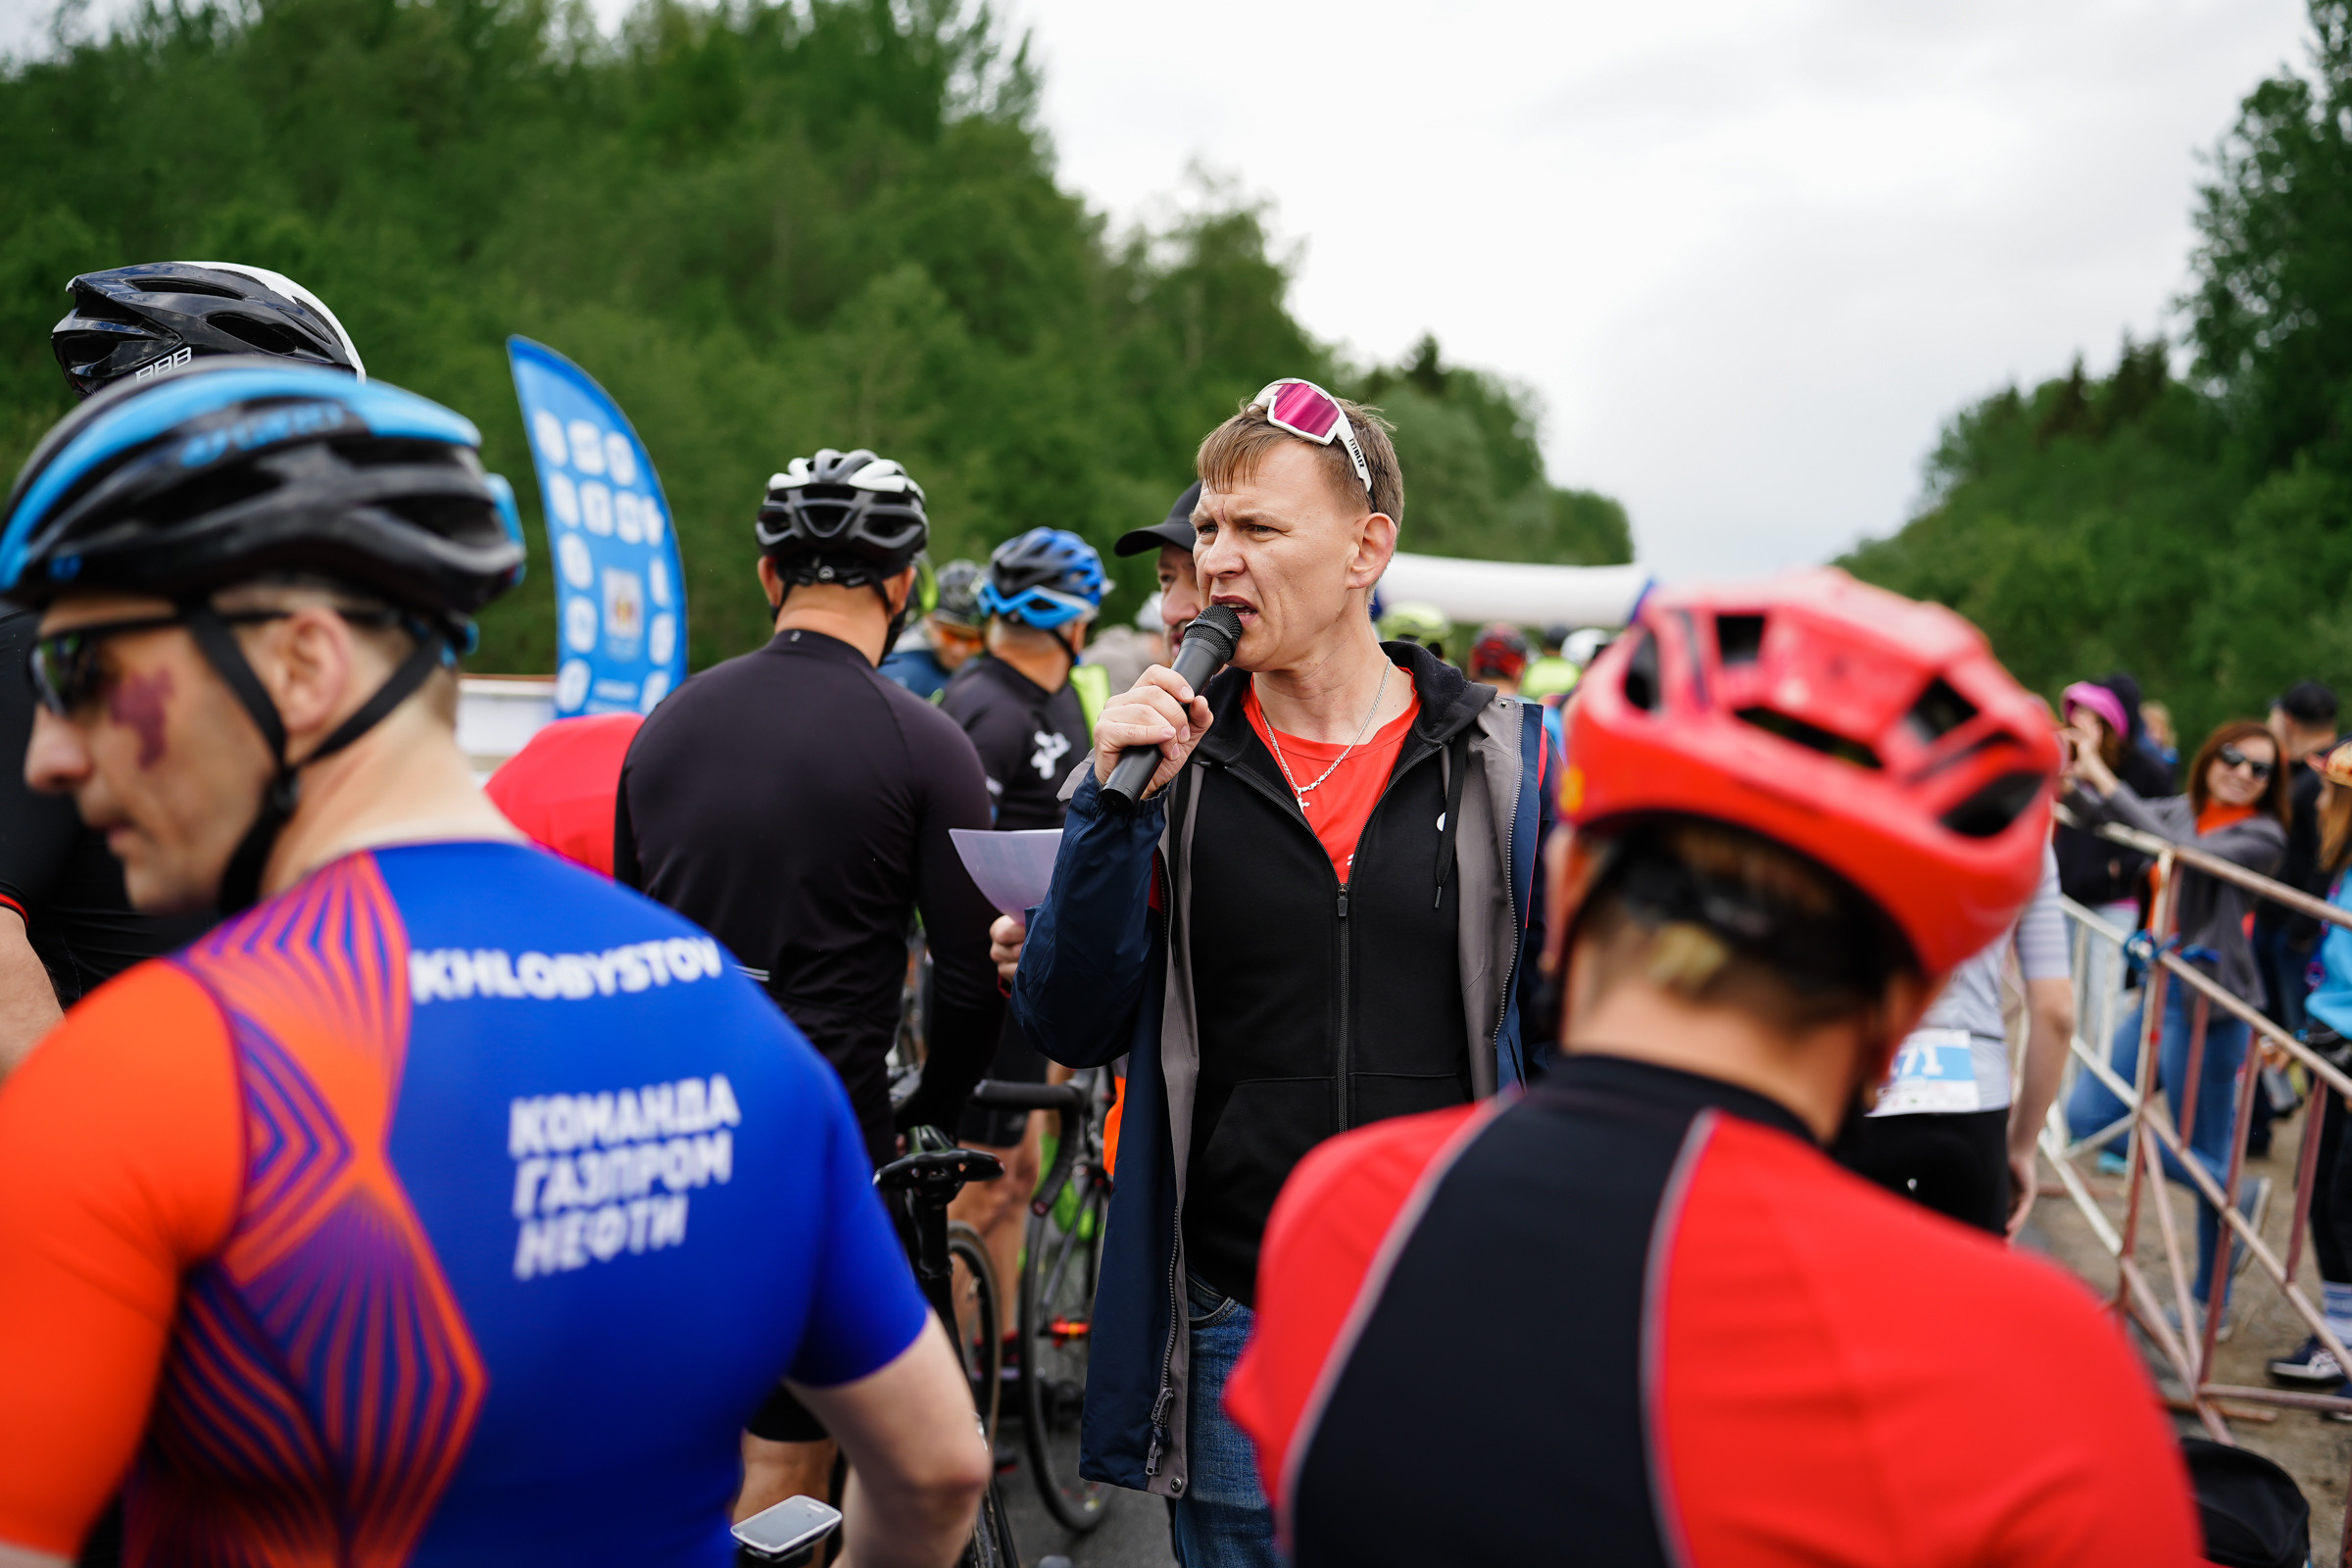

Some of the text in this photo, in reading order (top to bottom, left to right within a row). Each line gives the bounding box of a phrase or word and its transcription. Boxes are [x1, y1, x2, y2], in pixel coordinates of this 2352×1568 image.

[411, 937, 722, 1004] KHLOBYSTOV
[1890, 1047, 1943, 1077] 71
[509, 1074, 741, 1158] КОМАНДА
[513, 1129, 733, 1218] ГАЗПРОМ
[514, 1195, 688, 1280] НЕФТИ
